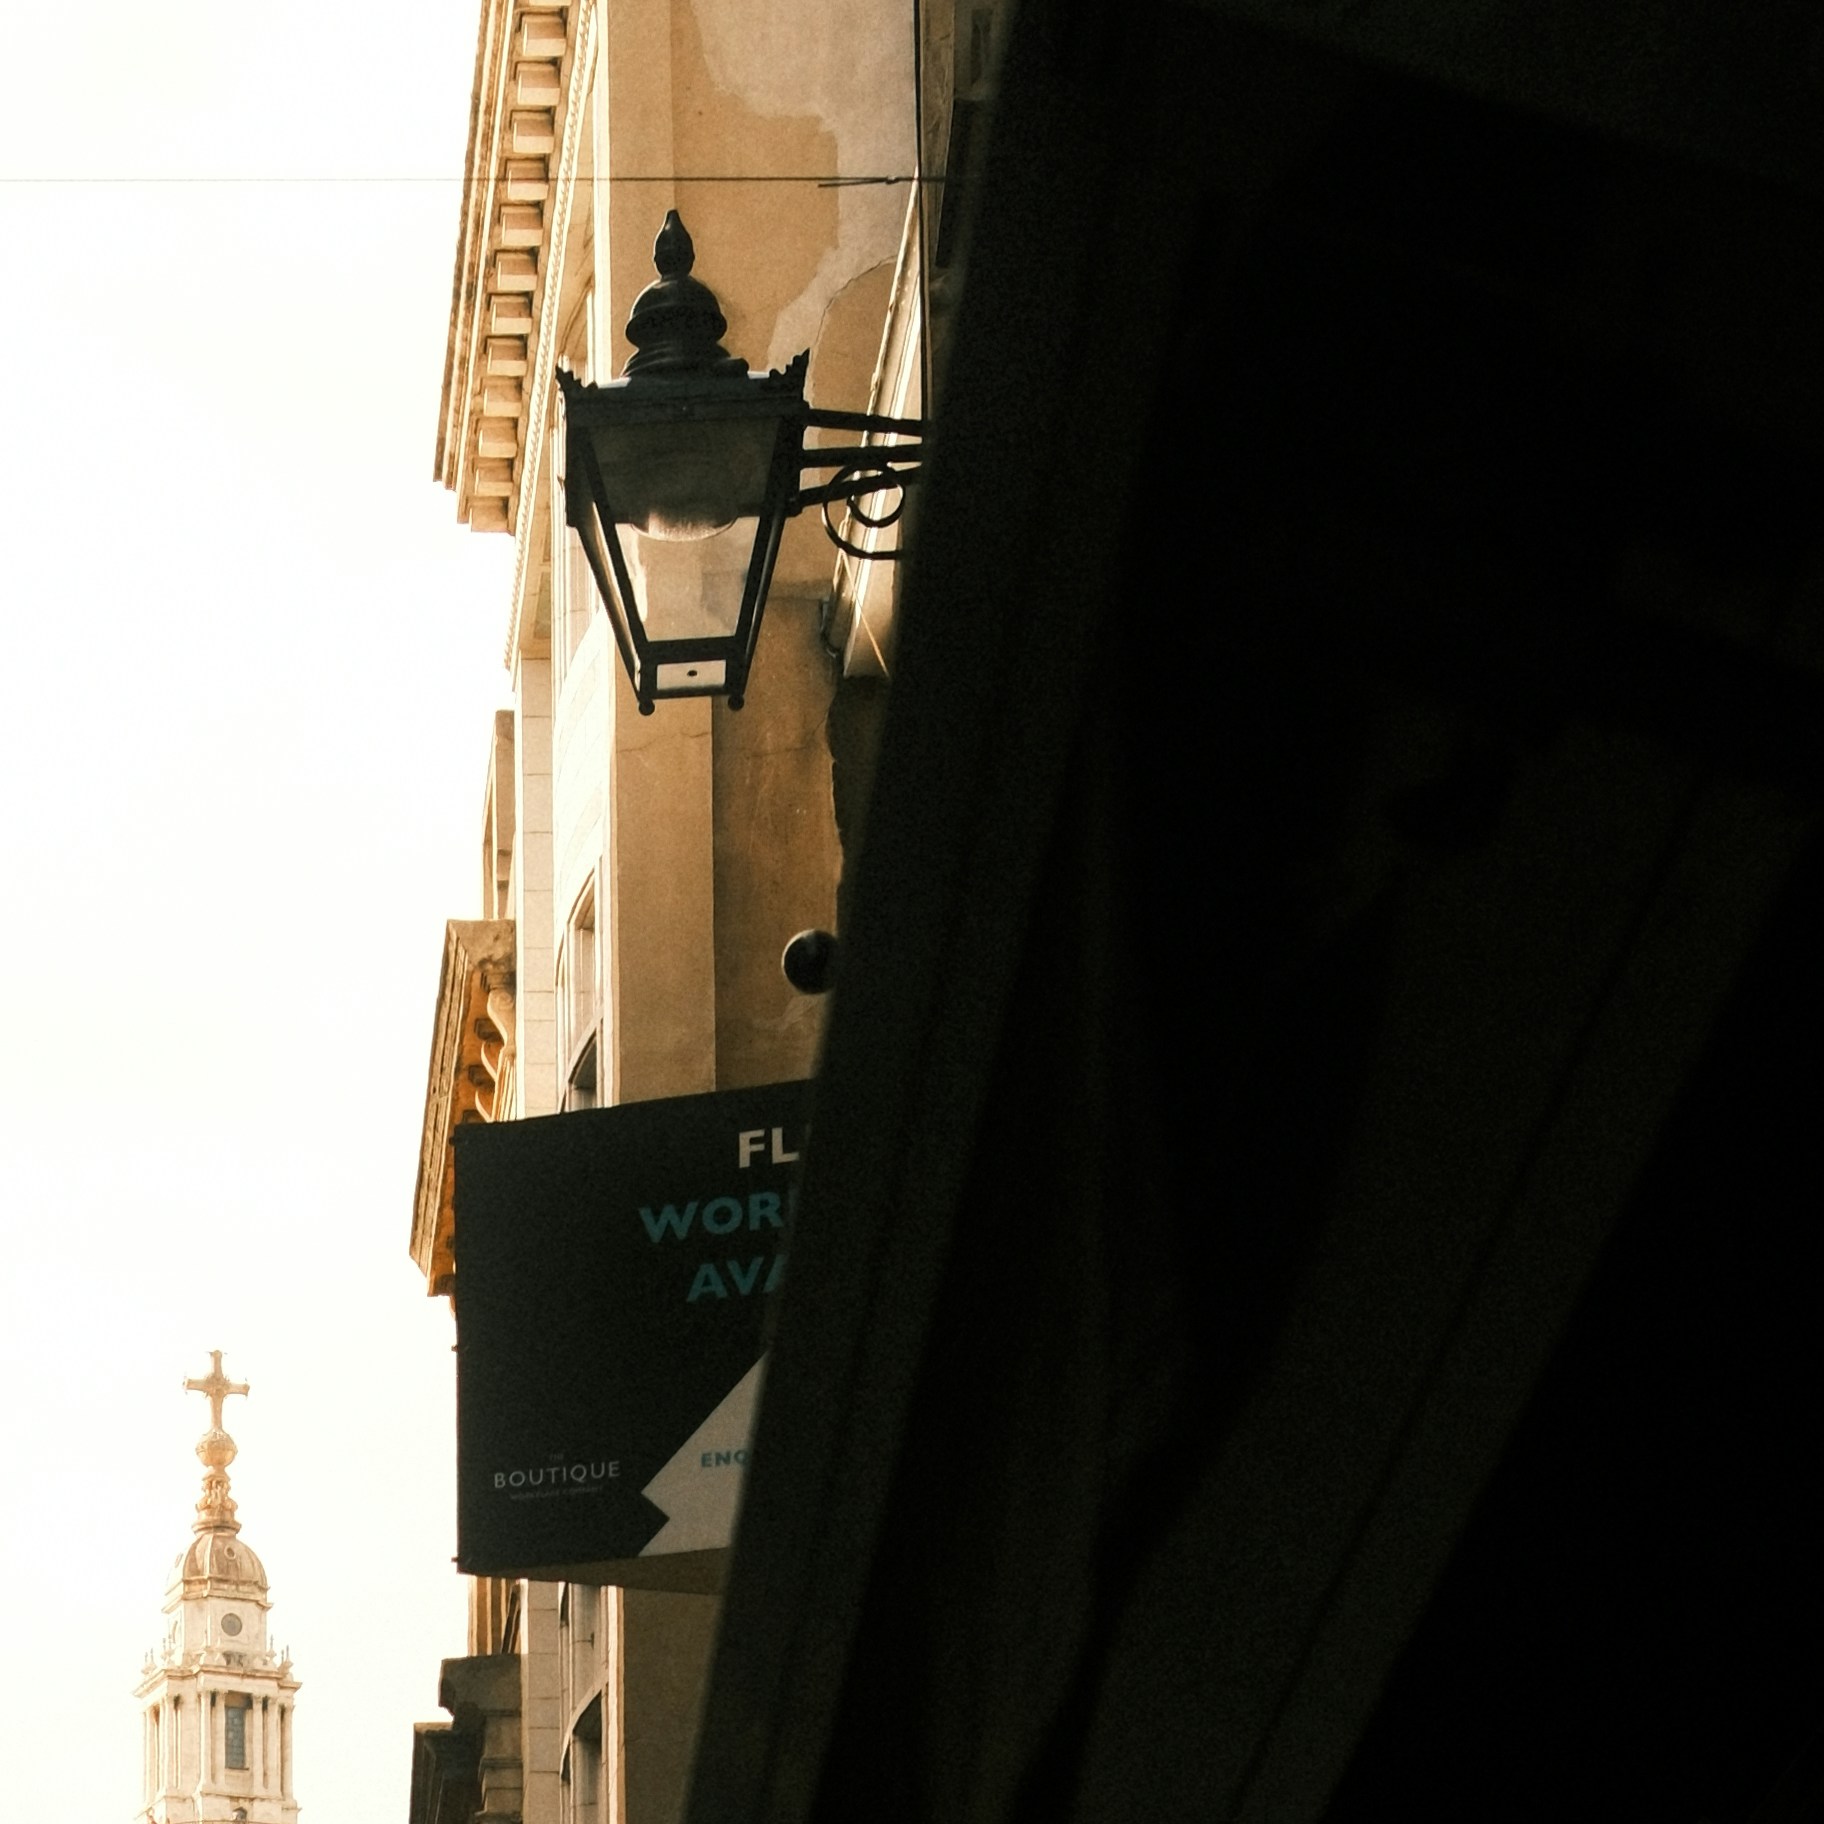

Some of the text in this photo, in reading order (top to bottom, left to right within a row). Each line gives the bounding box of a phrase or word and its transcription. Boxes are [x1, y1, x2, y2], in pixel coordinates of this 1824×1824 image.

[738, 1127, 802, 1168] FL
[639, 1187, 797, 1244] WOR
[493, 1460, 620, 1489] BOUTIQUE
